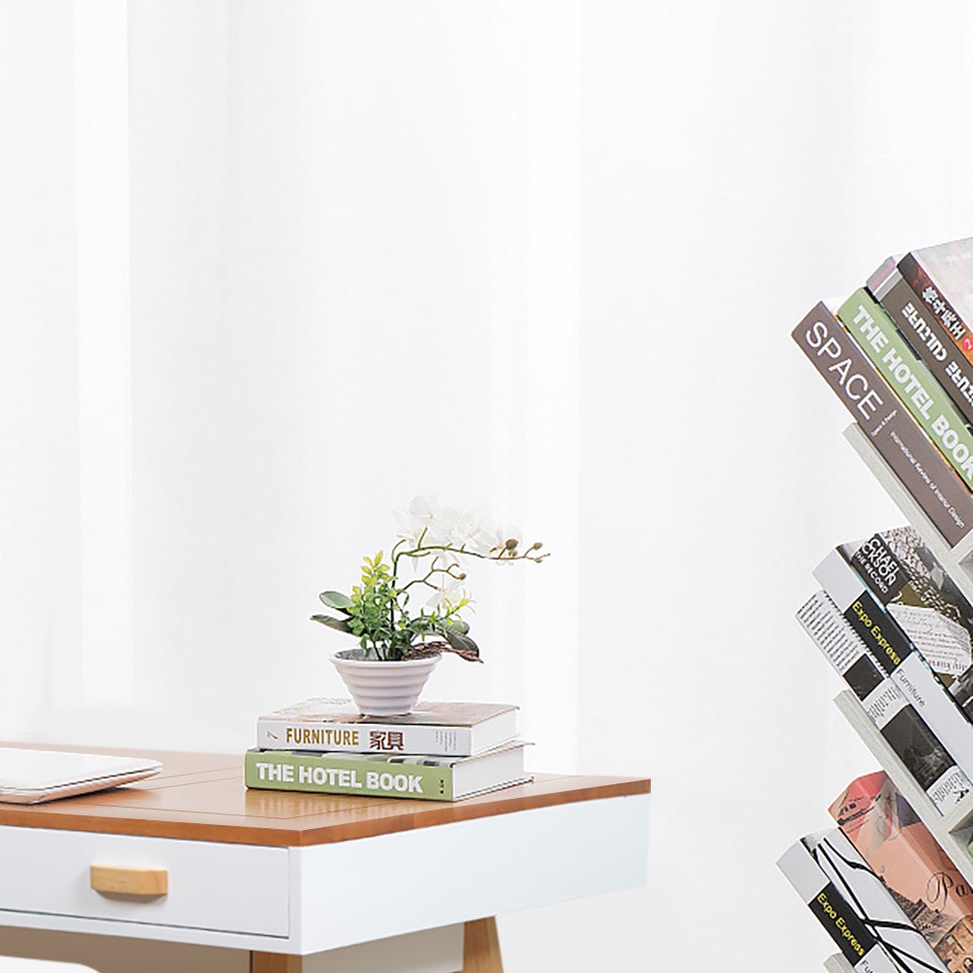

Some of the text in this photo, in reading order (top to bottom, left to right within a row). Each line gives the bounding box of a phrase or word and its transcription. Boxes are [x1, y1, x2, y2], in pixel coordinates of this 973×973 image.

[803, 319, 884, 421] SPACE
[850, 304, 973, 480] THE HOTEL BOOK
[852, 600, 874, 630] Expo
[868, 624, 901, 666] Express
[895, 668, 927, 708] Furniture
[286, 727, 359, 746] FURNITURE
[369, 730, 404, 751] 家具
[255, 762, 294, 782] THE
[298, 766, 362, 788] HOTEL
[366, 771, 423, 793] BOOK
[816, 892, 865, 958] Expo Express
